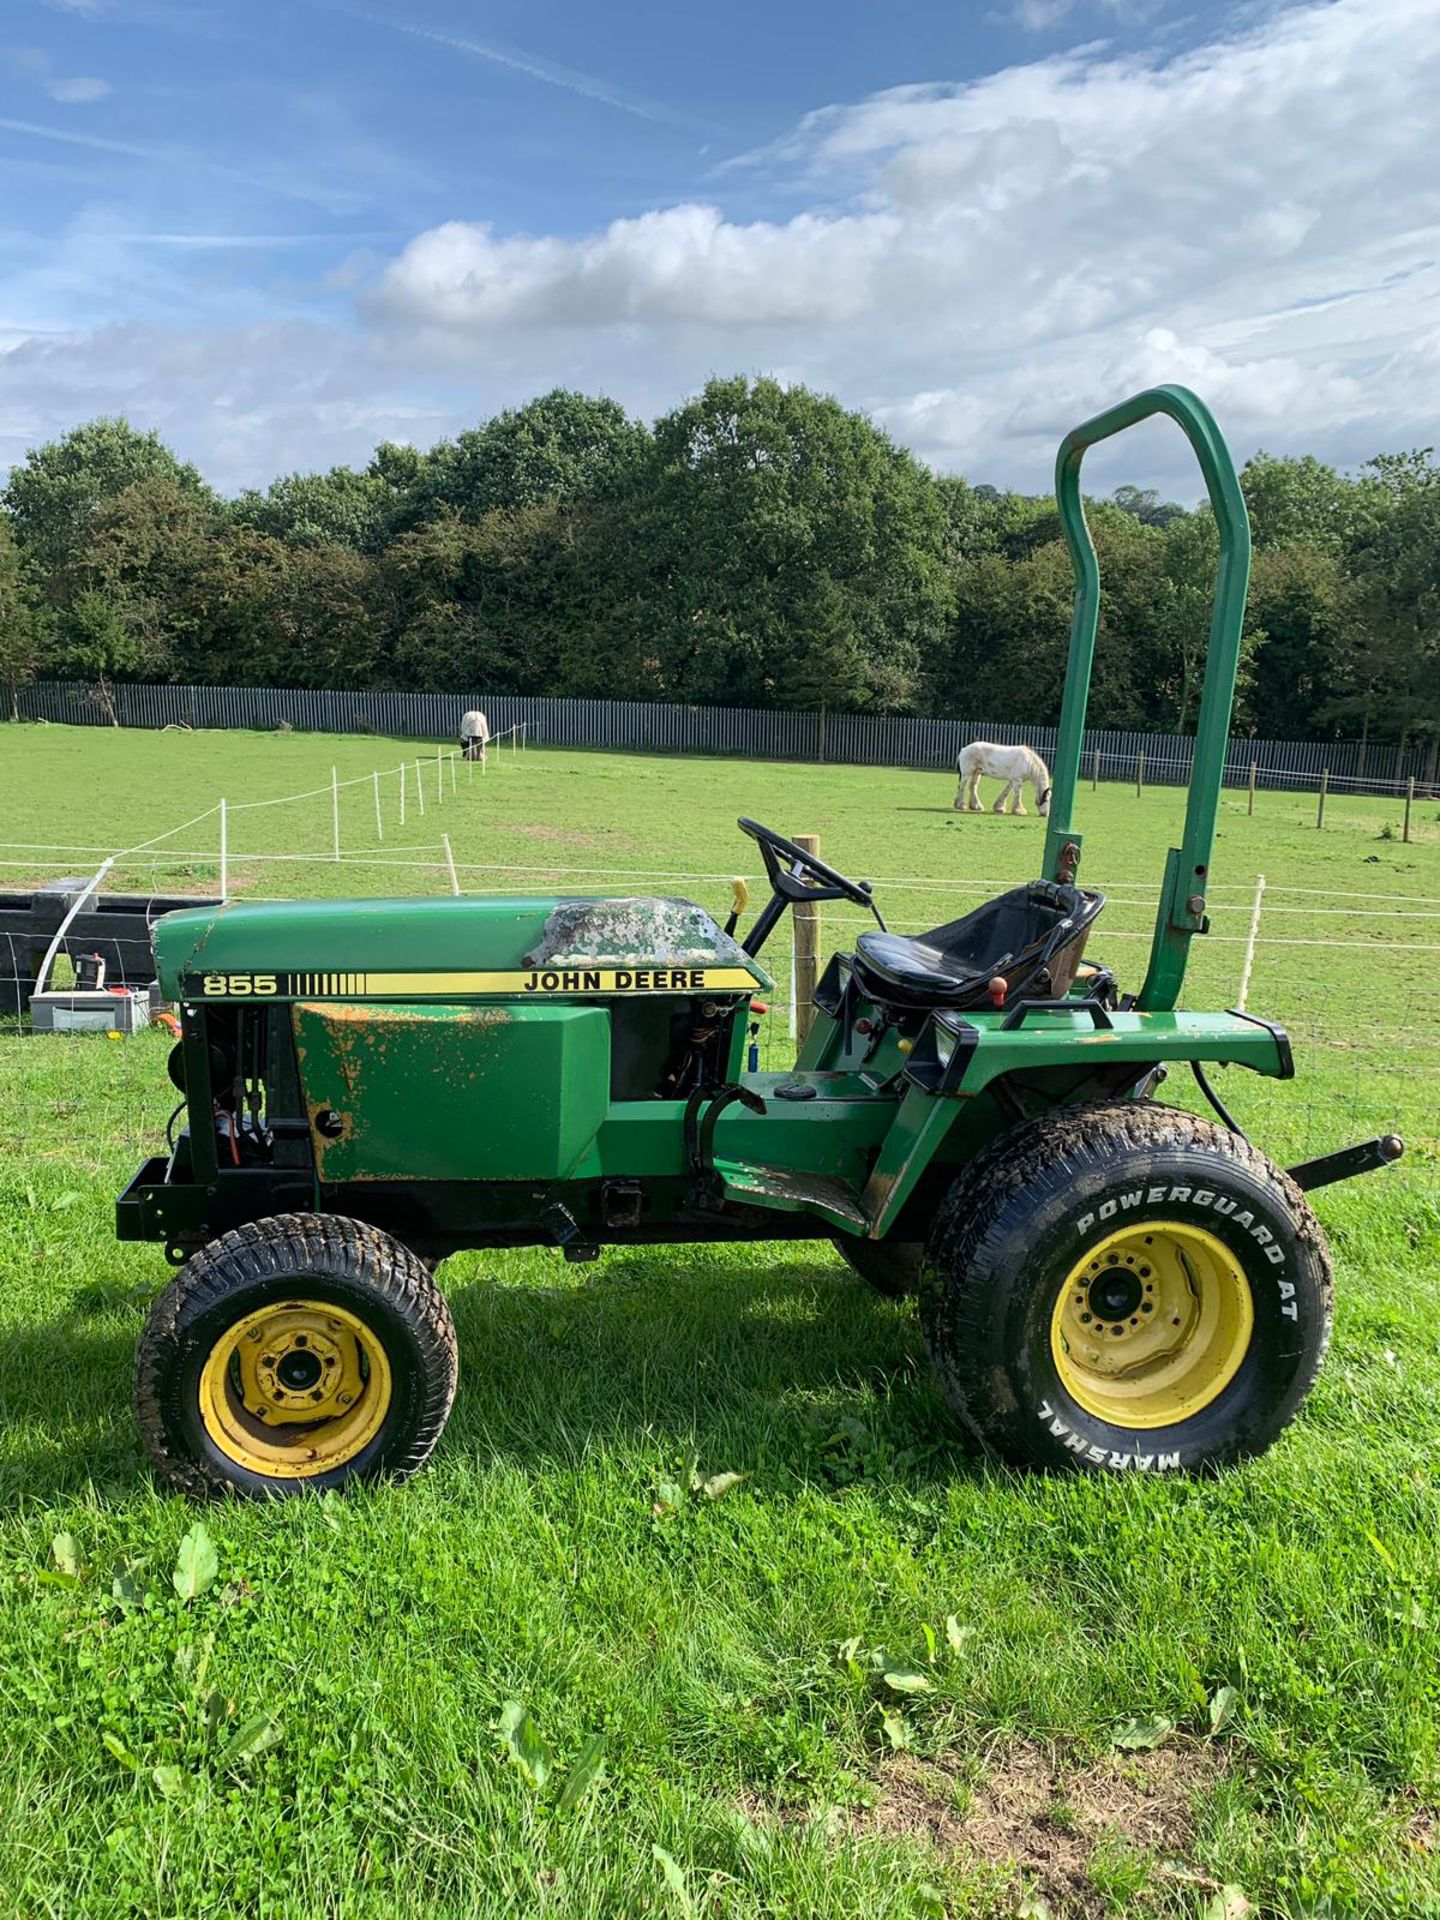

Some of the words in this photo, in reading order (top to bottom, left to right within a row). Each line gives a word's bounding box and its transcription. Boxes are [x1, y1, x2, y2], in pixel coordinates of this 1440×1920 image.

[203, 975, 277, 996] 855
[524, 972, 601, 991] JOHN
[615, 971, 705, 989] DEERE
[1077, 1187, 1286, 1264] POWERGUARD
[1277, 1279, 1298, 1322] AT
[1037, 1399, 1180, 1471] MARSHAL
